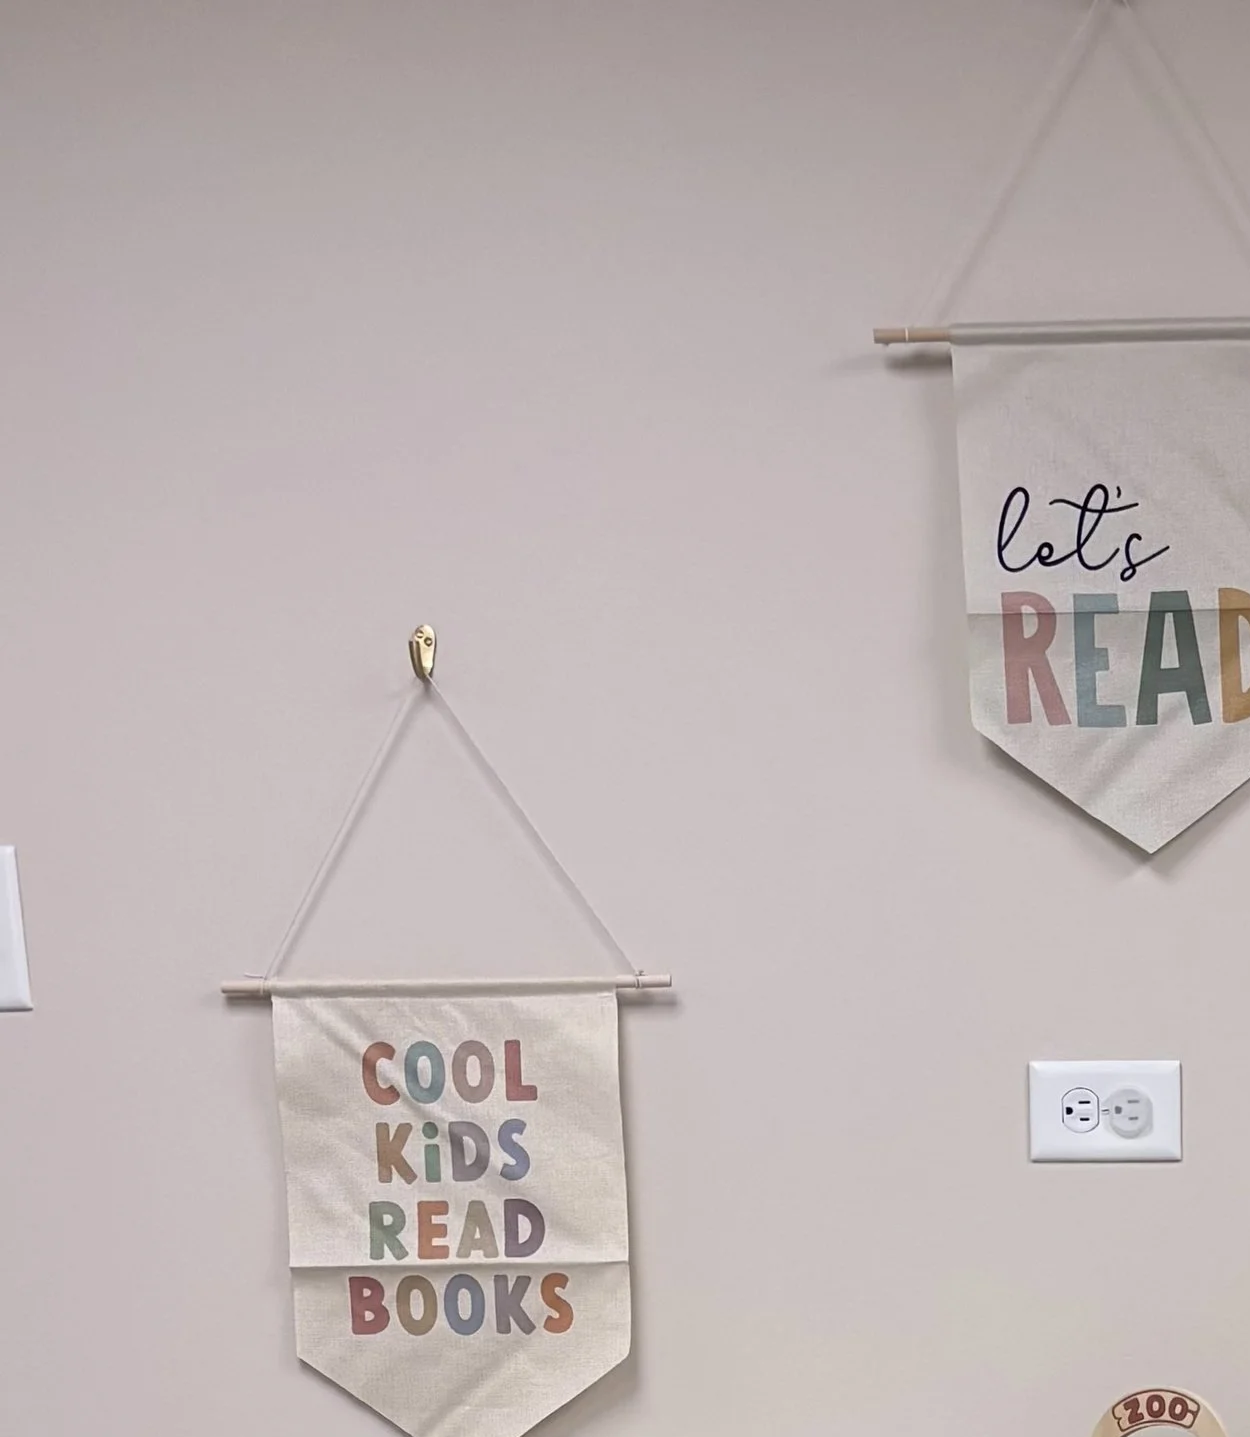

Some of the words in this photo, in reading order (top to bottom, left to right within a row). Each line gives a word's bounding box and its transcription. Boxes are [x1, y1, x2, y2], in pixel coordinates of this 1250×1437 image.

[362, 1039, 538, 1105] COOL
[368, 1198, 546, 1261] READ
[348, 1272, 575, 1336] BOOKS
[1123, 1393, 1190, 1425] ZOO
